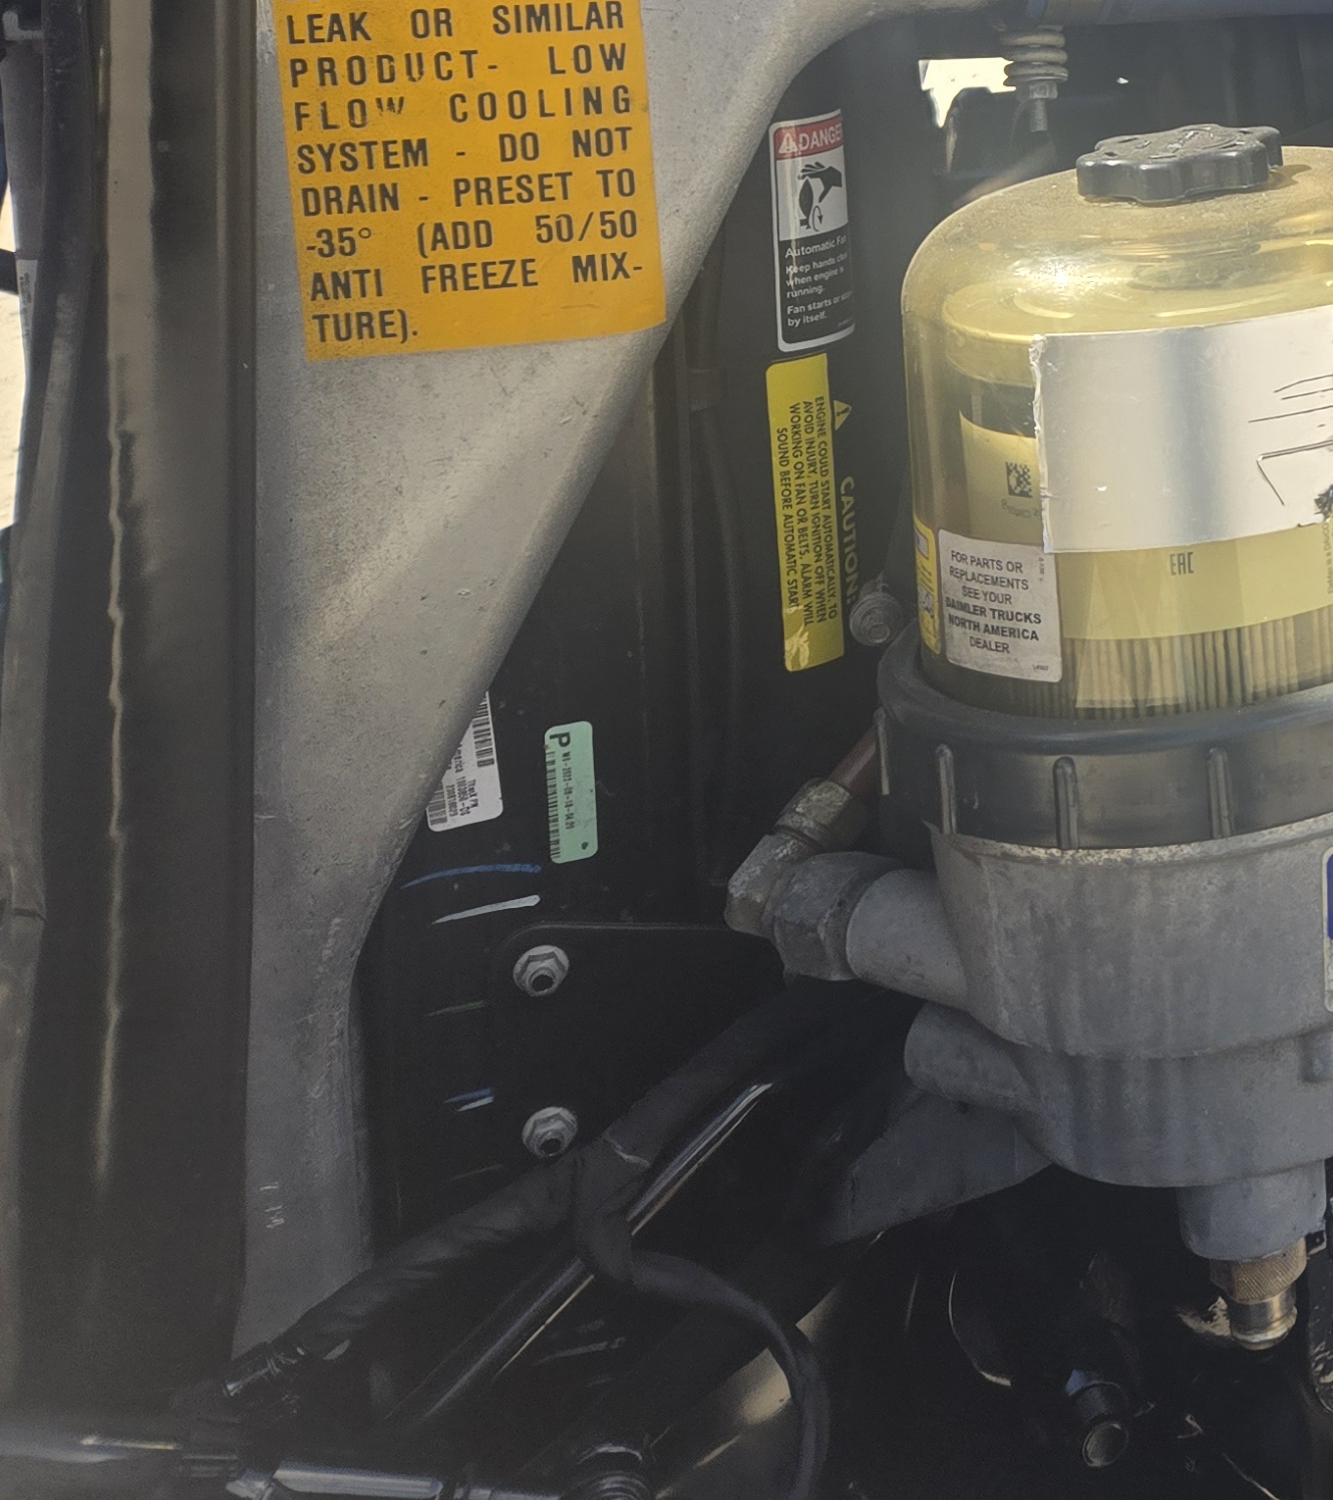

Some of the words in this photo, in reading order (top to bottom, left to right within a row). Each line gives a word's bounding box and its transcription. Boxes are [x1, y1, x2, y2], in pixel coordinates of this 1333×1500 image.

[286, 11, 372, 45] LEAK
[410, 7, 453, 39] OR
[492, 0, 624, 36] SIMILAR
[289, 49, 498, 89] PRODUCT-
[548, 43, 628, 76] LOW
[294, 96, 405, 132] FLOW
[449, 84, 632, 124] COOLING
[297, 138, 429, 176] SYSTEM
[498, 131, 540, 164] DO
[571, 126, 633, 160] NOT
[799, 121, 844, 150] DANGE
[301, 182, 401, 218] DRAIN
[453, 171, 574, 208] PRESET
[595, 168, 636, 199] TO
[306, 226, 373, 260] -35°
[416, 219, 493, 259] (ADD
[535, 209, 638, 246] 50/50
[784, 238, 836, 259] Automatic
[310, 267, 384, 302] ANTI
[421, 258, 539, 295] FREEZE
[571, 251, 643, 285] MIX-
[786, 263, 811, 275] Keep
[812, 257, 836, 270] hands
[786, 274, 812, 286] when
[813, 269, 838, 282] engine
[786, 284, 825, 299] running.
[787, 305, 806, 315] Fan
[807, 299, 832, 312] starts
[312, 308, 419, 345] TURE).
[787, 317, 801, 328] by
[803, 311, 828, 324] itself.
[789, 402, 803, 458] WORKING
[803, 400, 816, 434] AVOID
[814, 395, 829, 438] ENGINE
[776, 427, 790, 467] SOUND
[804, 437, 818, 479] INJURY,
[817, 440, 831, 478] COULD
[794, 462, 805, 480] ON
[780, 470, 793, 511] BEFORE
[795, 482, 807, 506] FAN
[808, 480, 820, 511] TURN
[820, 480, 833, 511] START
[797, 508, 809, 525] OR
[783, 514, 797, 576] AUTOMATIC
[811, 513, 823, 564] IGNITION
[840, 476, 859, 605] CAUTION:
[1322, 523, 1332, 551] DAVCO
[814, 566, 825, 586] OFF
[950, 549, 968, 565] FOR
[970, 556, 1003, 572] PARTS
[1006, 561, 1023, 574] OR
[801, 562, 813, 599] ALARM
[949, 565, 1029, 591] REPLACEMENTS
[816, 588, 828, 623] WHEN
[945, 596, 988, 618] DAIMLER
[989, 607, 1042, 624] TRUCKS
[962, 585, 980, 600] SEE
[981, 590, 1013, 605] YOUR
[804, 601, 815, 626] WILL
[828, 602, 838, 620] TO
[948, 614, 981, 632] NORTH
[983, 623, 1040, 641] AMERICA
[969, 635, 1011, 654] DEALER
[550, 732, 571, 748] P
